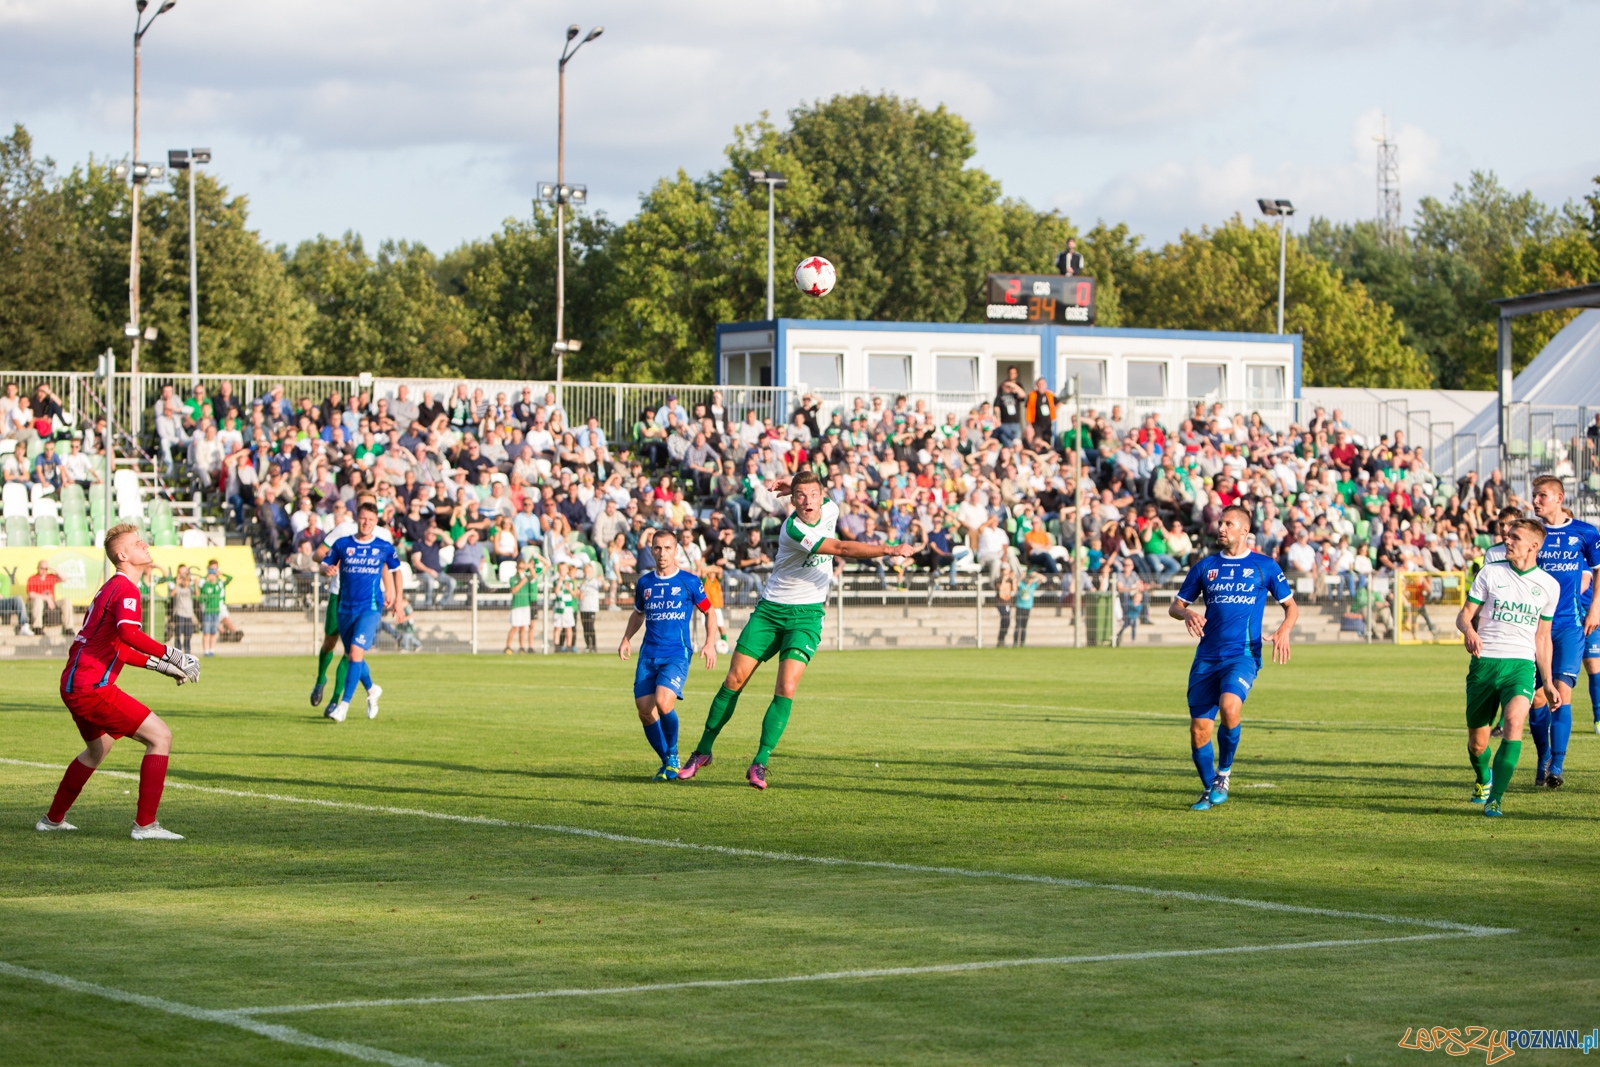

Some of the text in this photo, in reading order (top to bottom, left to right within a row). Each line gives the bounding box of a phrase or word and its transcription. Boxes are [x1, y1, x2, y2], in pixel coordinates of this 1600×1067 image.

[1005, 279, 1021, 304] 2
[1076, 282, 1091, 306] 0
[1029, 297, 1056, 320] 34
[1537, 550, 1562, 560] RAMY
[1235, 582, 1255, 592] DLA
[1493, 599, 1541, 616] FAMILY
[1492, 610, 1537, 626] HOUSE
